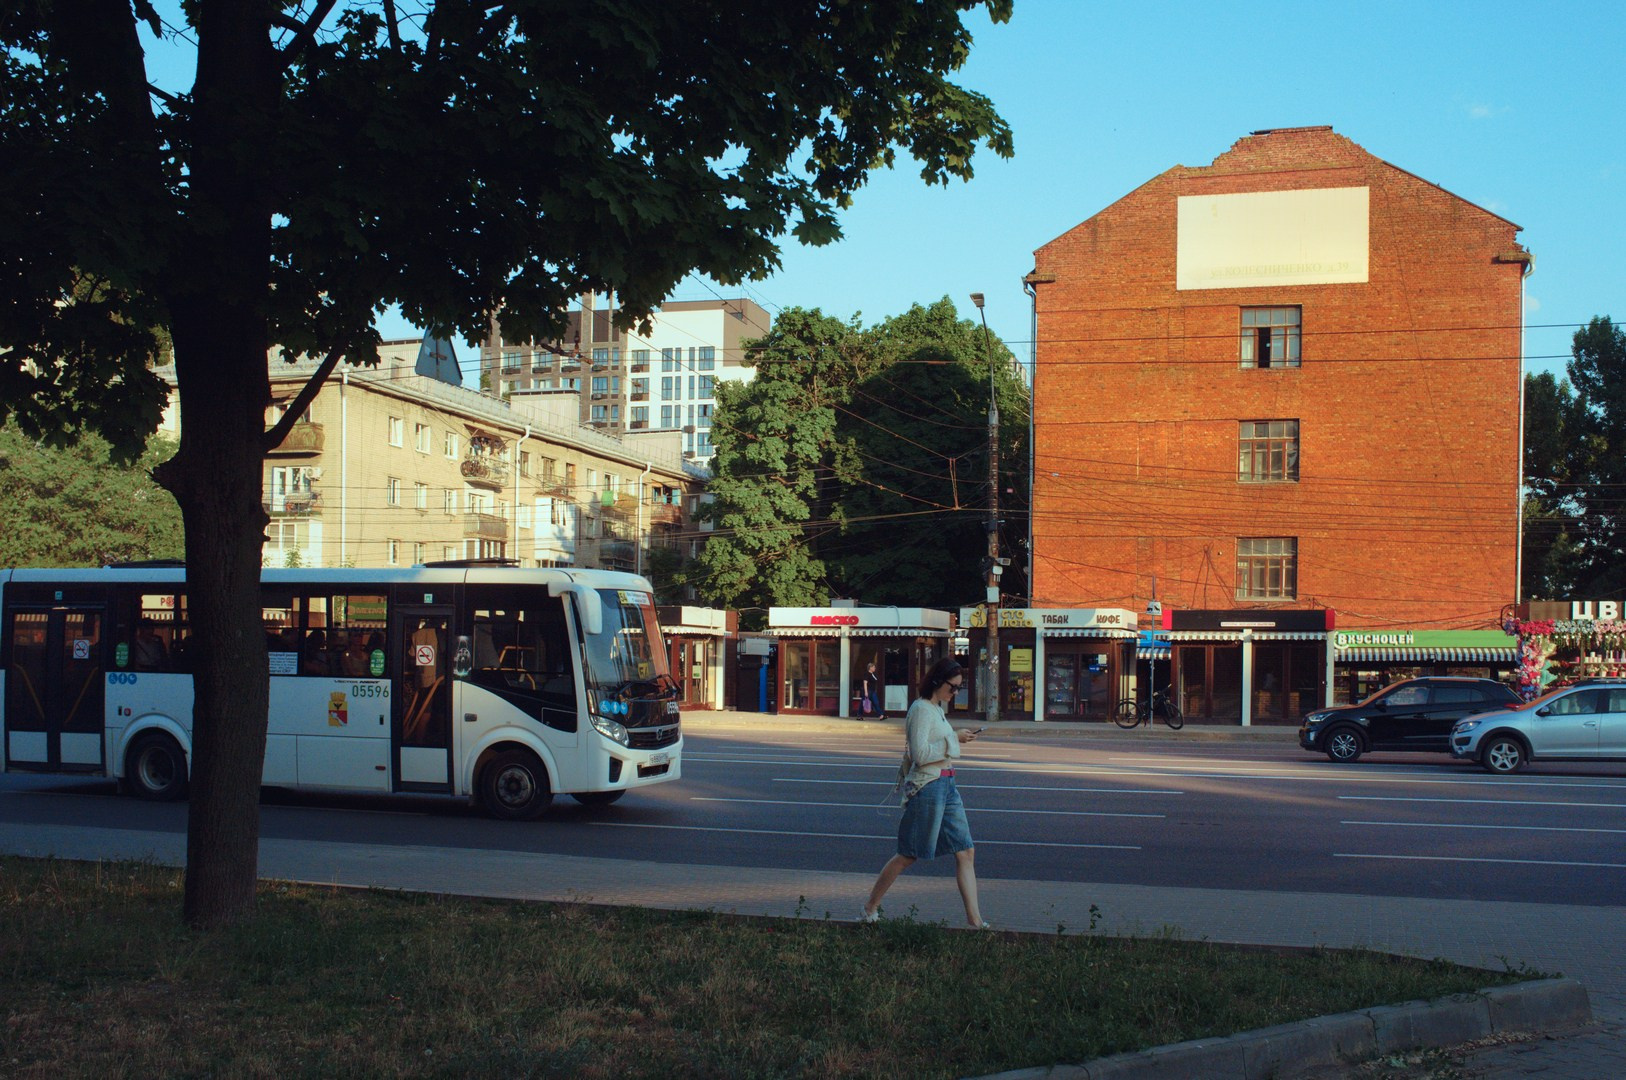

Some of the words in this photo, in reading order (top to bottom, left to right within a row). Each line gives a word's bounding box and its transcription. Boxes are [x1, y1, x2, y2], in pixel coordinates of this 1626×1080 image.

[1001, 610, 1025, 619] СТО
[1572, 601, 1626, 620] ЦВ
[1001, 619, 1033, 627] ЛОТО
[1042, 614, 1069, 624] ТАБАК
[1096, 614, 1121, 624] КОФЕ
[352, 685, 389, 698] 05596
